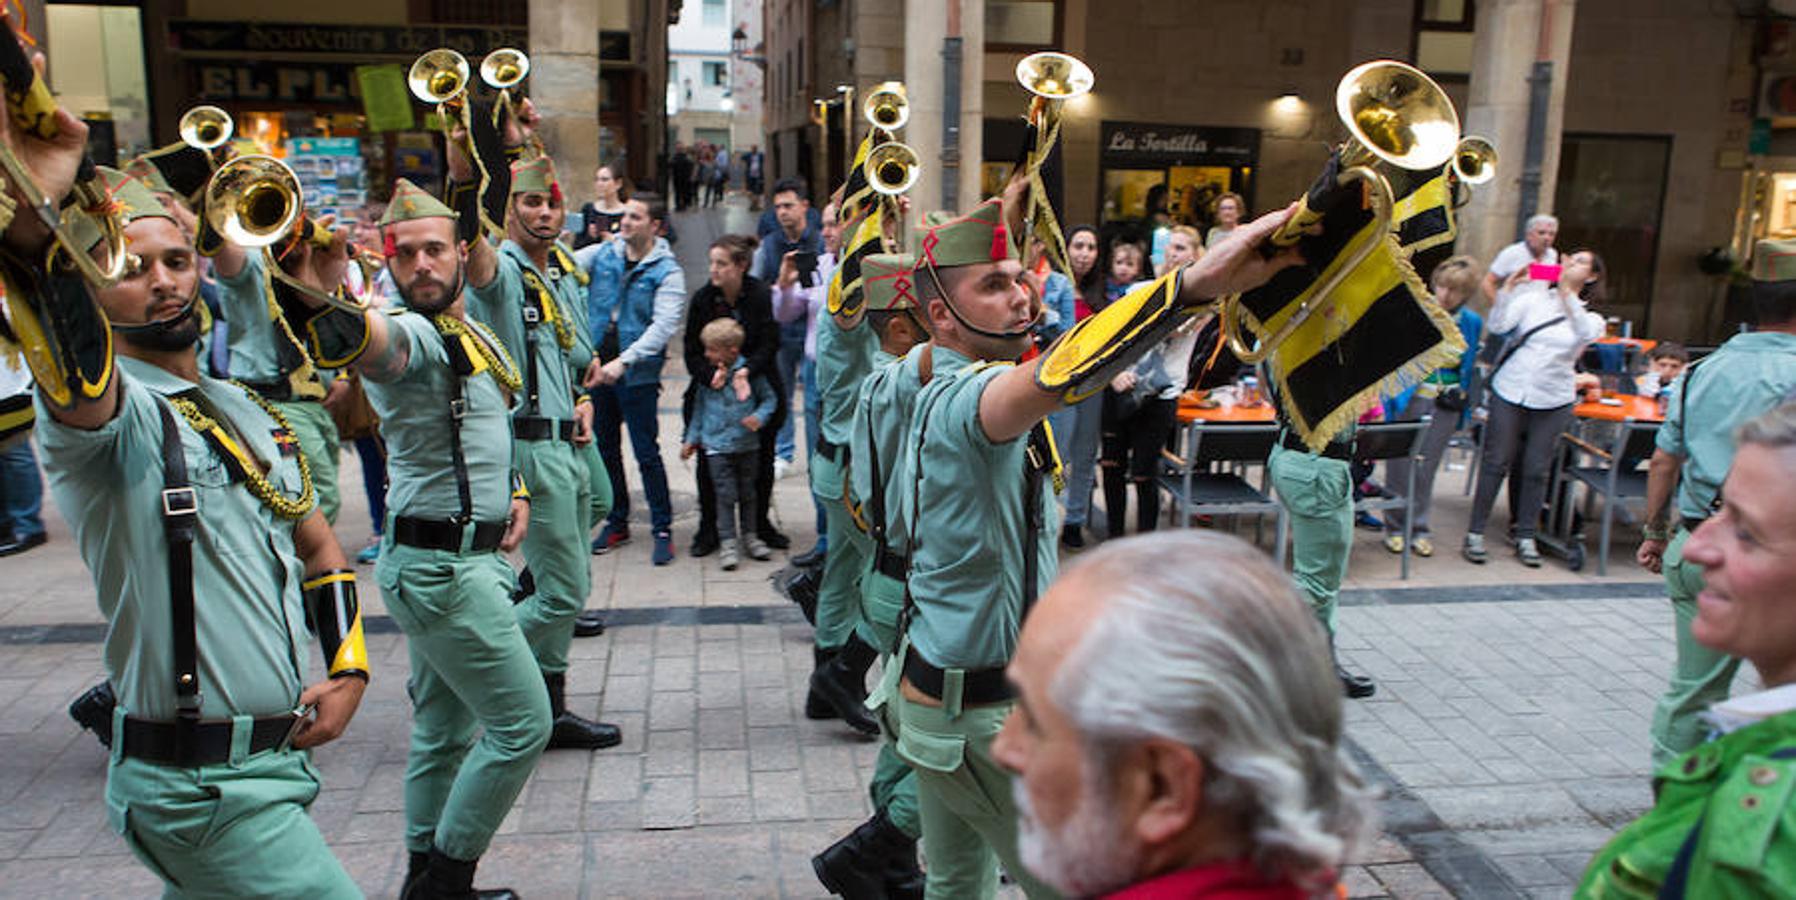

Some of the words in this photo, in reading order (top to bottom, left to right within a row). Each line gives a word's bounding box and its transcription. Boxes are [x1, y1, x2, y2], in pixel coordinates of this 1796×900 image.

[202, 66, 270, 98] EL
[1108, 131, 1135, 150] La
[1138, 132, 1208, 153] Tortilla
